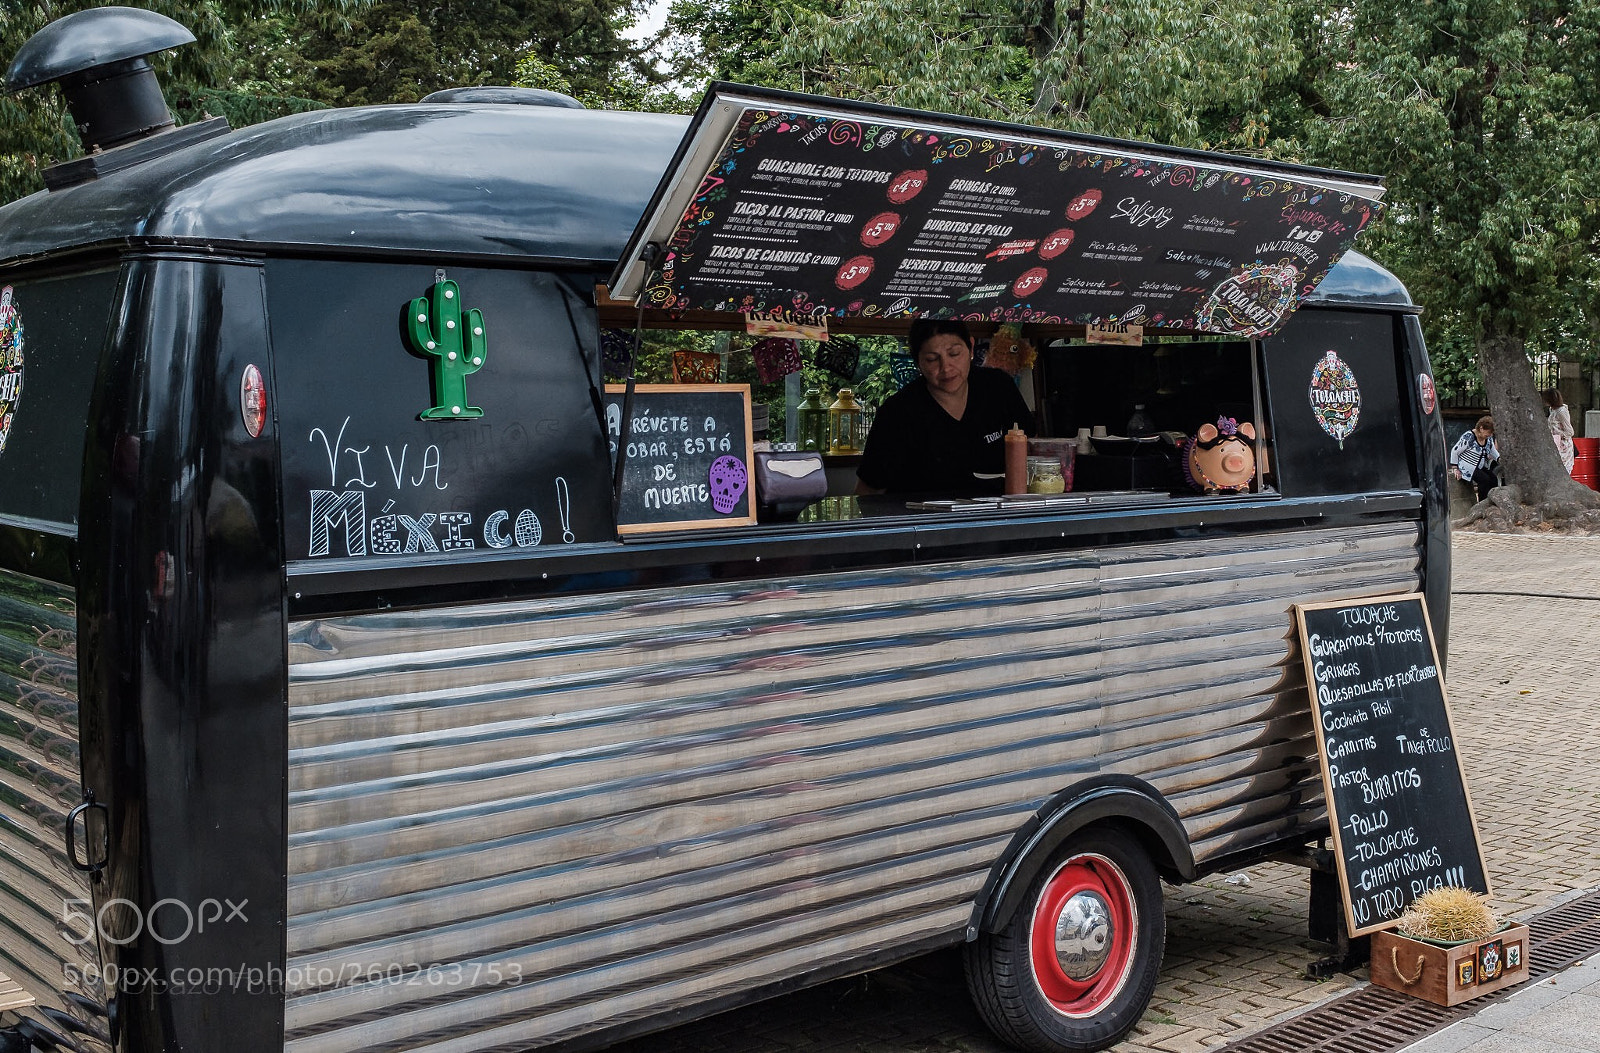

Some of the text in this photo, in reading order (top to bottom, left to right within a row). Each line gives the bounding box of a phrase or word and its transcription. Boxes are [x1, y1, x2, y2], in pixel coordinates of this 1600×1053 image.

[798, 124, 828, 145] TACOS
[758, 159, 824, 177] GUACAMOLE
[822, 166, 846, 179] CON
[845, 168, 892, 184] TOTOPOS
[949, 178, 990, 193] GRINGAS
[733, 201, 768, 217] TACOS
[767, 206, 783, 218] AL
[783, 207, 826, 221] PASTOR
[1110, 197, 1174, 228] Salsas
[923, 219, 1013, 237] BURRITOS DE POLLO
[710, 245, 745, 260] TACOS
[744, 249, 762, 261] DE
[760, 250, 813, 264] CARNITAS
[1088, 241, 1105, 250] Pico
[1116, 243, 1138, 253] Gallo
[1166, 249, 1192, 262] Salsa
[899, 258, 986, 274] BURRITO TOLOACHE
[1062, 277, 1085, 287] Salsa
[1313, 389, 1357, 404] TOLOACHE
[607, 403, 716, 436] ARÉVETE A
[309, 416, 448, 490] VIVA
[684, 433, 731, 455] ESTÁ
[653, 463, 677, 481] DE
[644, 484, 709, 509] MUERTE
[1337, 605, 1400, 627] TOLOACHE
[1309, 633, 1375, 657] GUACAMOLE
[1314, 661, 1361, 682] GRINGAS
[1318, 679, 1384, 706] QUESADILLAS
[1384, 674, 1396, 690] DE
[1395, 672, 1416, 688] FLOR
[1322, 700, 1392, 732] Cochinita Pibil
[1327, 735, 1377, 760] CARNITAS
[1396, 734, 1427, 756] TINGA
[1427, 736, 1451, 752] POLLO
[1330, 764, 1370, 789] PASTOR
[1360, 767, 1421, 804] BURRITOS
[1351, 897, 1370, 926] NO
[1371, 886, 1404, 918] TODO
